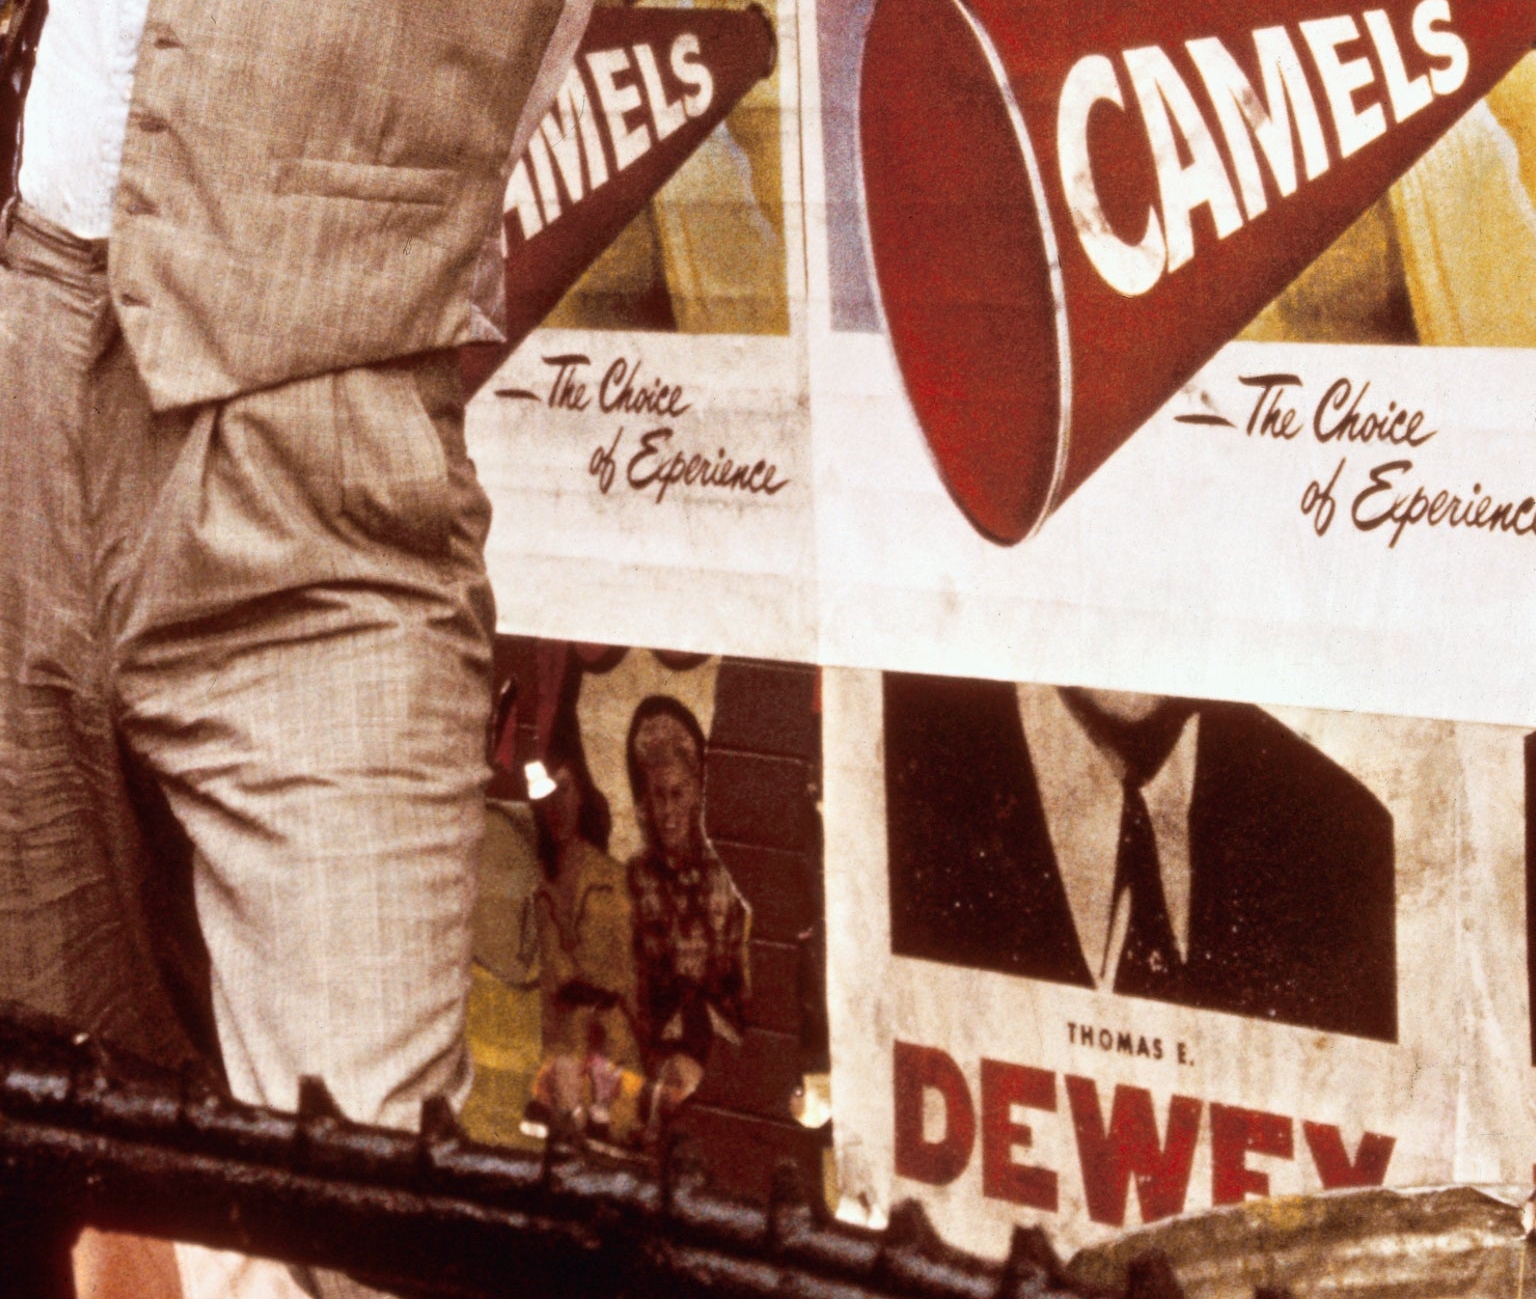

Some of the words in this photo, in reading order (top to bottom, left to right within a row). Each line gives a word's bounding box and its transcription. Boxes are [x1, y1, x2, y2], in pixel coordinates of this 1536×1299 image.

[598, 357, 692, 417] Choice
[1313, 377, 1439, 448] Choice
[588, 426, 624, 494] of
[627, 427, 790, 504] Experience
[1300, 456, 1347, 538] of
[1351, 459, 1536, 550] Experienc
[1067, 1022, 1164, 1061] THOMAS
[1176, 1041, 1195, 1066] E.
